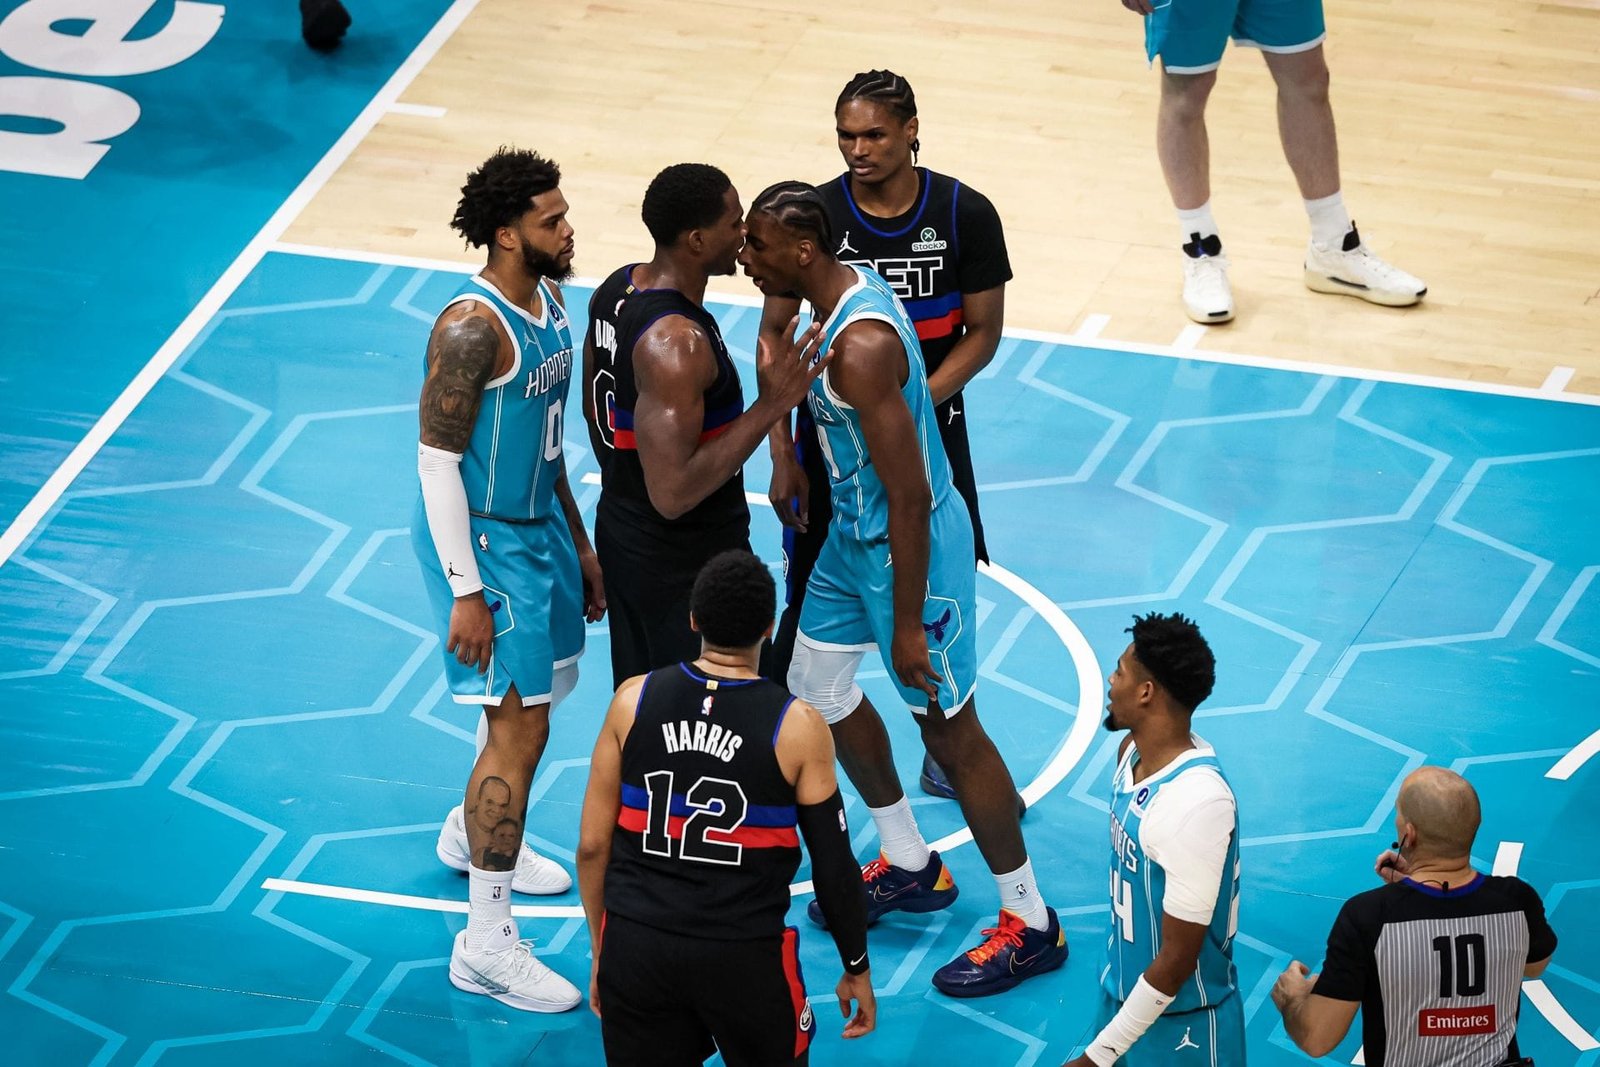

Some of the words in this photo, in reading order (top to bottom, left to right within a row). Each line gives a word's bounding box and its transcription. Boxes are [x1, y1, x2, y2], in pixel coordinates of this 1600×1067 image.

[912, 241, 946, 251] StockX
[840, 256, 943, 298] ET
[525, 348, 574, 399] HORNET
[543, 398, 563, 462] 0
[662, 720, 743, 763] HARRIS
[643, 770, 748, 866] 12
[1111, 812, 1138, 873] NETS
[1110, 866, 1134, 943] 4
[1432, 933, 1486, 998] 10
[1426, 1014, 1489, 1029] Emirates
